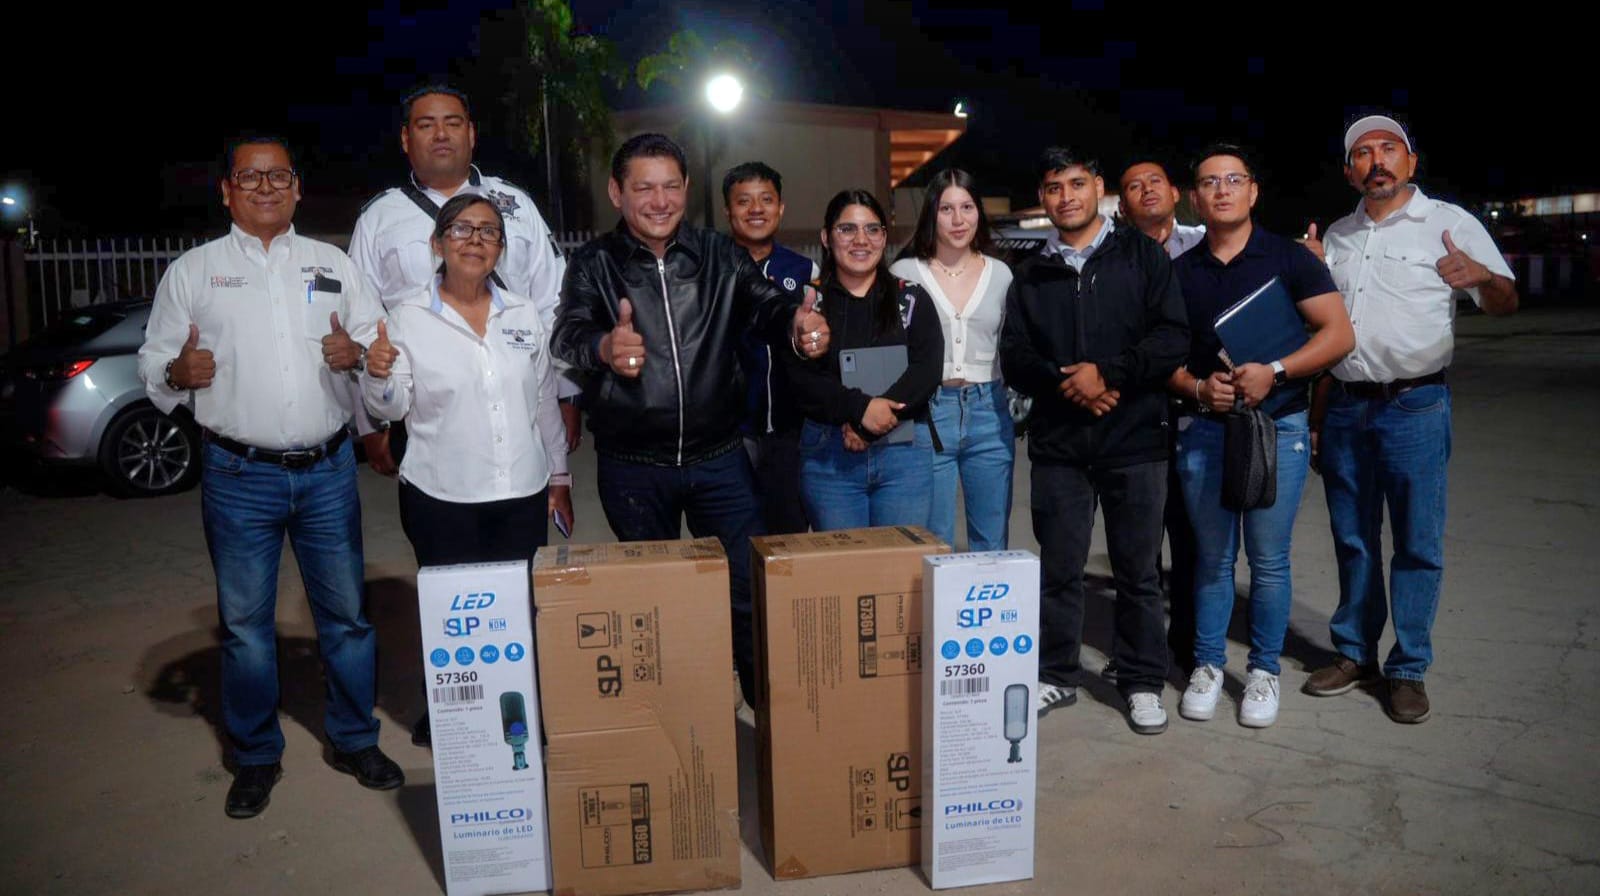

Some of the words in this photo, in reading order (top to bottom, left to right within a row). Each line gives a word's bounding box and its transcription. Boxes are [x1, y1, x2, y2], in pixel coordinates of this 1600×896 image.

[965, 584, 1010, 601] LED
[450, 592, 496, 611] LED
[489, 620, 506, 629] NOM
[860, 598, 874, 636] 57360
[436, 671, 478, 685] 57360
[945, 663, 985, 677] 57360
[945, 799, 1016, 815] PHILCO
[451, 808, 525, 824] PHILCO
[945, 818, 990, 830] Luminario
[992, 817, 1003, 825] de
[1005, 816, 1022, 824] LED
[453, 828, 500, 840] Luminario
[502, 826, 514, 835] de
[516, 825, 533, 833] LED
[634, 825, 650, 862] 57360
